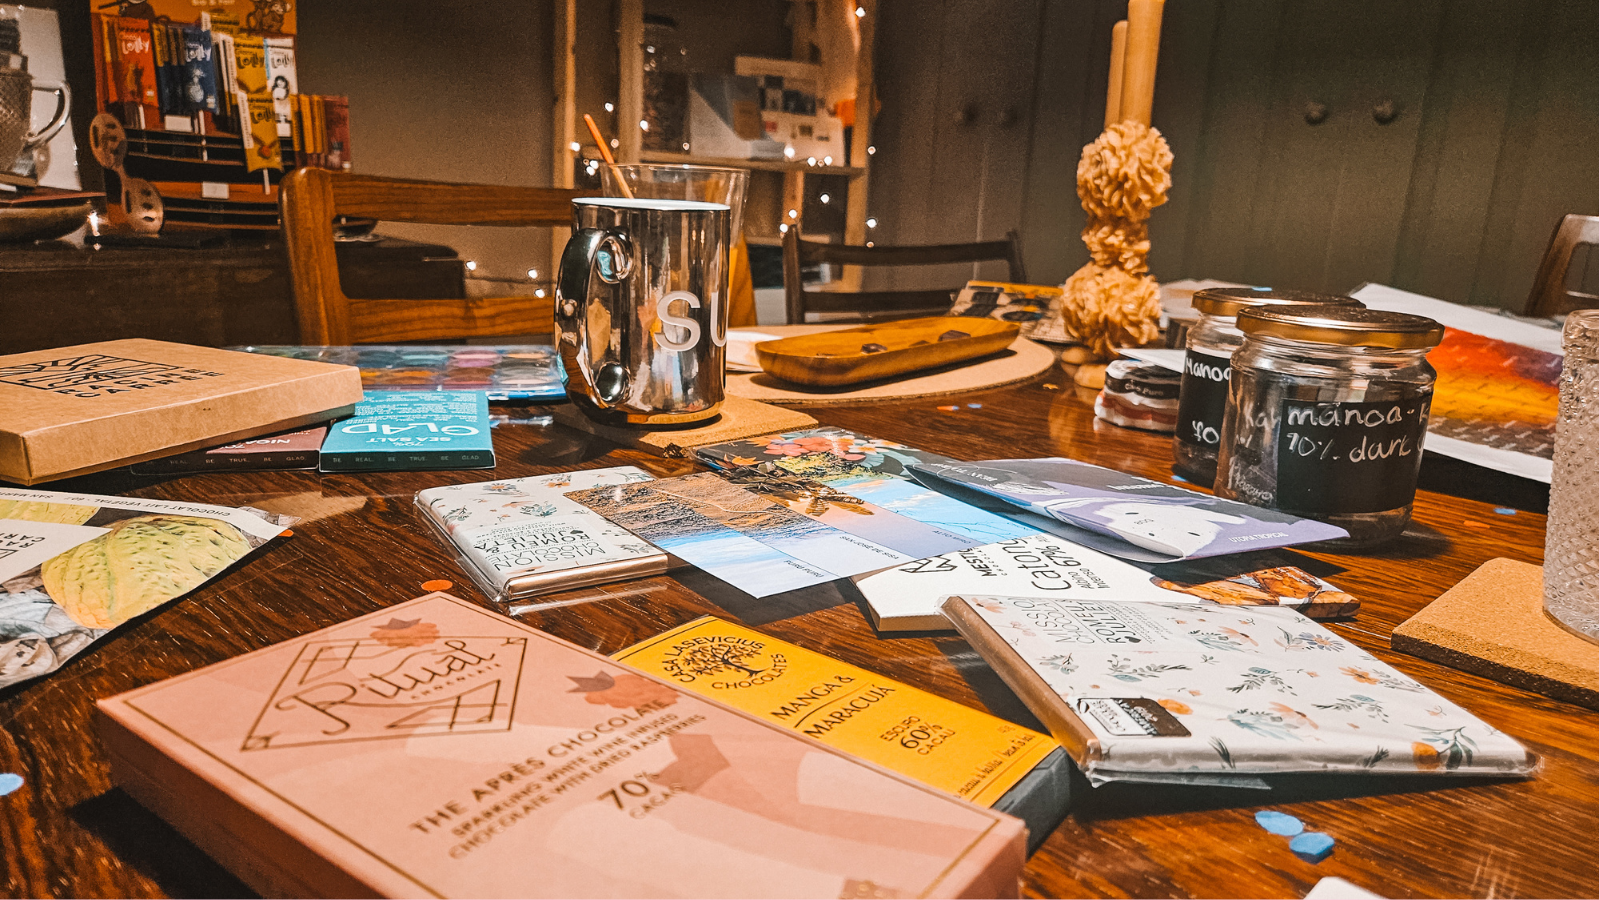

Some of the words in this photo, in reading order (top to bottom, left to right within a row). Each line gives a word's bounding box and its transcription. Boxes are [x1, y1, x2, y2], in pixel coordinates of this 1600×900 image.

[341, 422, 480, 436] GLAD
[1348, 435, 1412, 463] dark
[487, 541, 600, 562] CHOCOLATE
[494, 547, 607, 571] MISSION
[510, 534, 590, 550] ROMEU
[1029, 597, 1095, 644] CHOCOLA
[1066, 604, 1127, 644] ROMEU
[1076, 600, 1137, 637] JULIET
[274, 640, 496, 736] Ritual
[662, 658, 696, 683] CASA
[711, 653, 787, 689] CHOCOLATES
[770, 682, 842, 720] MANGA
[834, 675, 855, 684] &
[803, 684, 896, 739] MARACUJÁ
[900, 721, 943, 749] 60%
[917, 728, 956, 756] CACAU
[409, 799, 469, 835] THE
[546, 698, 672, 758] CHOCOLATE
[451, 780, 543, 838] SPARKLING
[544, 755, 588, 783] WHITE
[591, 735, 627, 758] WINE
[626, 712, 679, 740] INFUSED
[448, 794, 551, 860] CHOCOLATE
[552, 770, 592, 795] WITH
[592, 749, 631, 774] DRIED
[632, 712, 706, 753] RASPBERRIES
[597, 769, 661, 811] 70%
